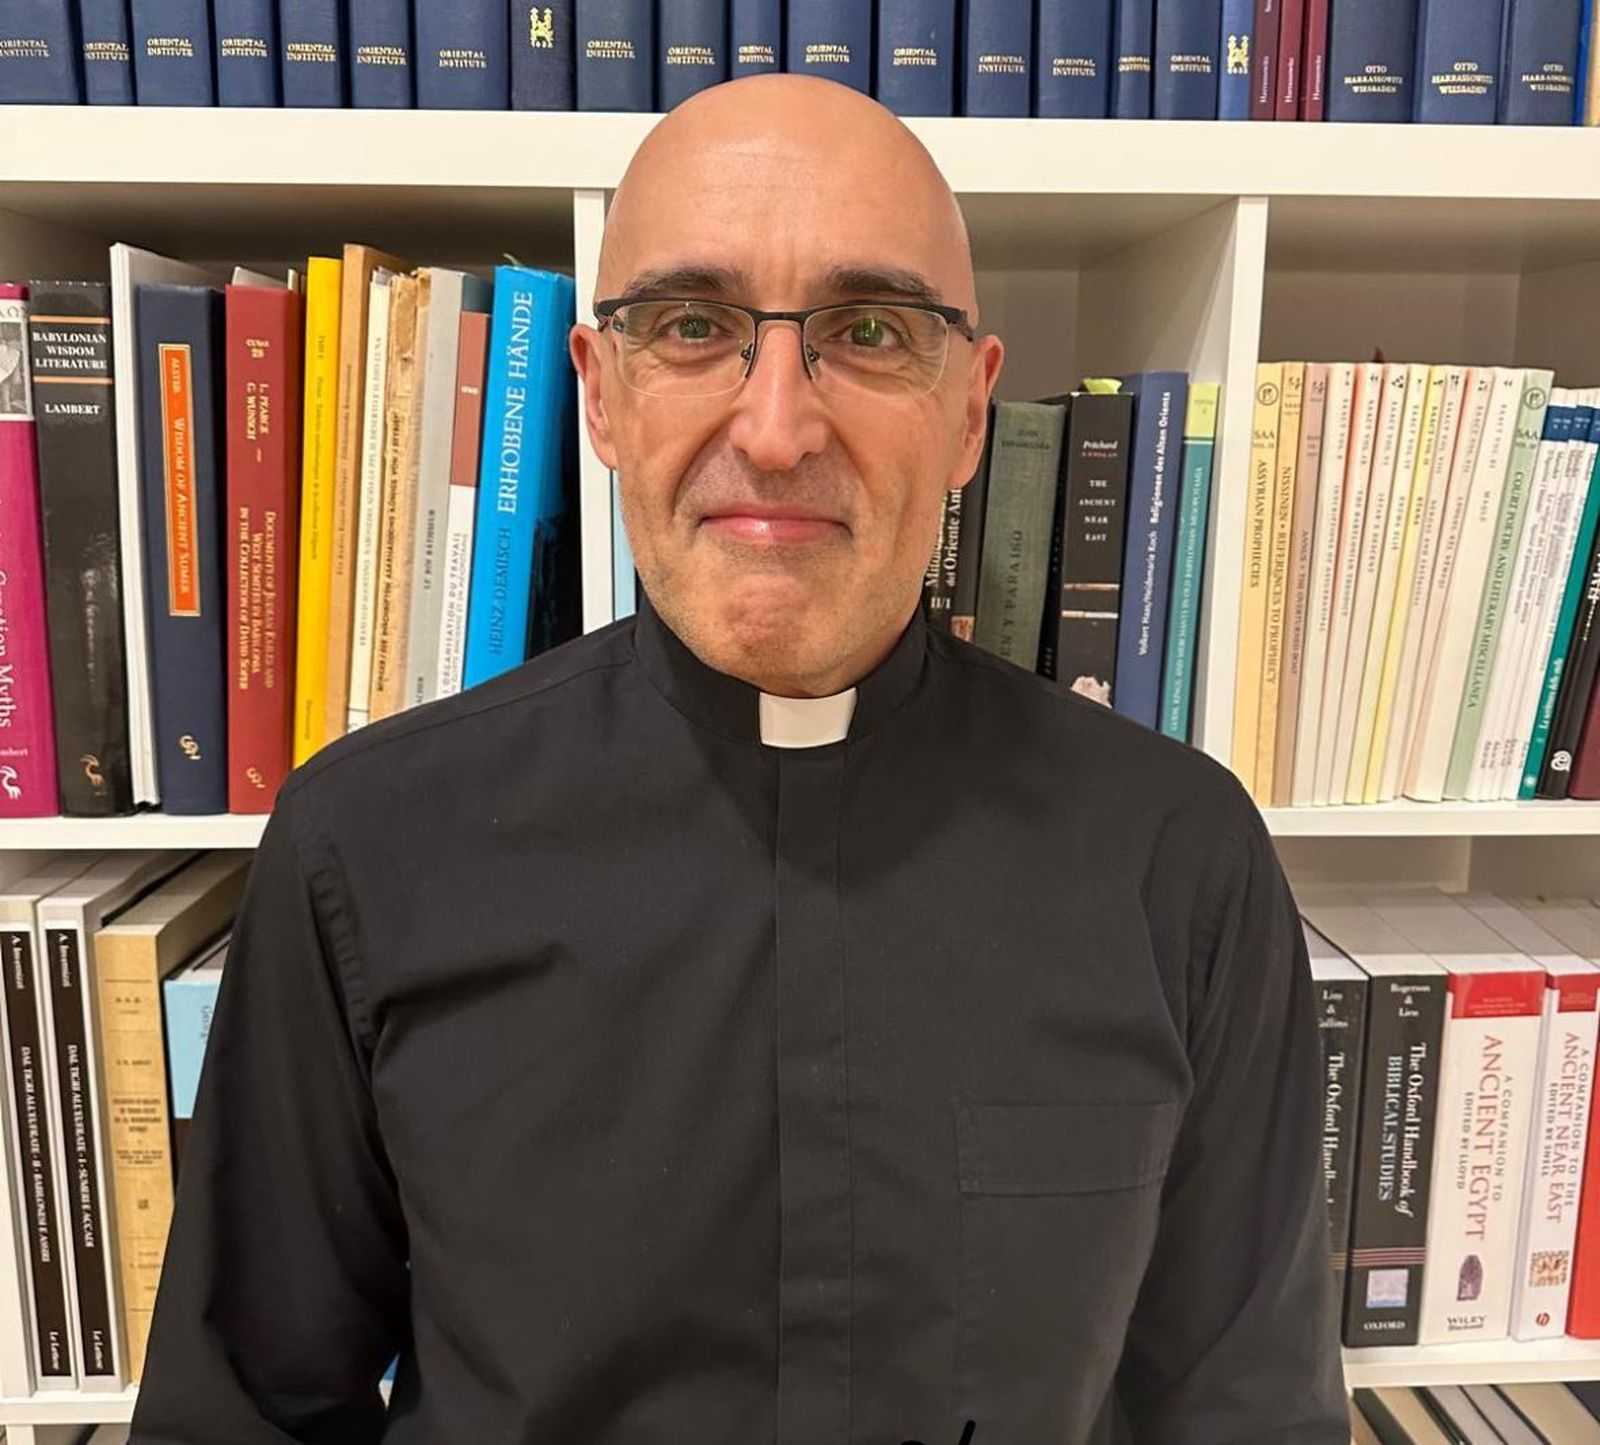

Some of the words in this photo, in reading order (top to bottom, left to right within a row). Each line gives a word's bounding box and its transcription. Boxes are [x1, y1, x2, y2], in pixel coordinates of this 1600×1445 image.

[147, 38, 192, 47] ORIENTAL
[221, 38, 267, 47] ORIENTAL
[287, 43, 336, 53] ORIENTAL
[357, 46, 405, 56] ORIENTAL
[587, 40, 634, 49] ORIENTAL
[668, 47, 713, 55] ORIENTAL
[738, 46, 774, 54] ORIENTAL
[806, 44, 849, 53] ORIENTAL
[147, 47, 194, 57] INSTITUTE
[221, 48, 268, 57] INSTITUTE
[286, 52, 337, 62] INSTITUTE
[356, 55, 407, 65] INSTITUTE
[439, 50, 486, 59] ORIENTAL
[586, 49, 635, 59] INSTITUTE
[667, 56, 715, 65] INSTITUTE
[738, 54, 774, 63] INSTITUTE
[805, 54, 850, 63] INSTITUTE
[893, 56, 937, 66] INSTITUTE
[894, 48, 936, 57] ORIENTAL
[979, 55, 1025, 65] ORIENTAL
[1171, 55, 1211, 63] ORIENTAL
[438, 59, 487, 68] INSTITUTE
[978, 64, 1026, 74] INSTITUTE
[1053, 58, 1096, 68] ORIENTAL
[1053, 67, 1096, 77] INSTITUTE
[1170, 63, 1212, 73] INSTITUTE
[1365, 65, 1387, 74] OTTO
[1454, 62, 1478, 72] OTTO
[33, 332, 107, 344] BABYLONIAN
[507, 291, 533, 379] HÄNDE
[47, 345, 95, 356] WISDOM
[35, 357, 107, 369] LITERATURE
[45, 403, 101, 415] LAMBERT
[246, 396, 256, 440] WUNSCH
[1157, 391, 1171, 427] Orients
[174, 417, 186, 469] WISDOM
[1155, 430, 1167, 455] Alten
[1255, 431, 1274, 440] SAA
[1517, 429, 1538, 439] SAA
[497, 387, 526, 515] ERHOBENE
[1153, 456, 1164, 474] des
[176, 473, 186, 488] OF
[1089, 480, 1107, 488] THE
[1253, 459, 1267, 517] ASSYRIAN
[1149, 474, 1165, 524] Religionen
[1279, 466, 1292, 523] NISSINEN
[1508, 471, 1524, 509] COURT
[1079, 498, 1116, 506] ANCIENT
[176, 494, 188, 550] ANCIENT
[1084, 516, 1108, 524] NEAR
[240, 522, 249, 541] THE
[1085, 533, 1107, 542] EAST
[1499, 511, 1516, 550] POETRY
[944, 518, 960, 570] Oriente
[1146, 531, 1158, 552] Koch
[1250, 518, 1265, 588] PROPHECIES
[494, 526, 512, 599] DEMISCH
[1271, 532, 1287, 606] REFERENCES
[1495, 556, 1508, 578] AND
[178, 552, 190, 593] SUMER
[240, 544, 250, 607] COLLECTION
[947, 571, 957, 587] del
[931, 596, 951, 609] II/1
[1483, 580, 1503, 632] LITERARY
[1002, 617, 1014, 627] Y
[1271, 608, 1281, 623] TO
[489, 601, 504, 656] HEINZ
[240, 626, 250, 657] DAVID
[1138, 625, 1150, 656] Volkert
[1266, 625, 1279, 684] PROPHECY
[1467, 634, 1492, 708] MISCELLANEA
[1404, 995, 1413, 1004] &
[1327, 1005, 1335, 1014] &
[22, 1046, 31, 1066] DAL
[68, 1045, 77, 1064] DAL
[1408, 1042, 1427, 1070] The
[1581, 1049, 1590, 1057] A
[1327, 1052, 1345, 1081] The
[1557, 1033, 1580, 1119] ANCIENT
[1383, 1056, 1402, 1131] BIBLICAL
[1405, 1074, 1423, 1122] Oxford
[1472, 1036, 1503, 1155] ANCIENT
[1324, 1084, 1341, 1132] Oxford
[1462, 1092, 1474, 1132] EDITED
[1546, 1083, 1558, 1123] EDITED
[1570, 1064, 1589, 1150] COMPANION
[1494, 1090, 1511, 1176] COMPANION
[1544, 1127, 1553, 1140] BY
[1460, 1137, 1469, 1150] BY
[1551, 1126, 1570, 1176] NEAR
[1379, 1132, 1397, 1200] STUDIES
[1399, 1126, 1420, 1198] Handbook
[1541, 1145, 1552, 1178] SNELL
[1568, 1157, 1579, 1175] TO
[1457, 1154, 1468, 1189] LLOYD
[79, 1169, 89, 1205] SUMERI
[1492, 1184, 1502, 1202] TO
[1565, 1182, 1577, 1206] THE
[1394, 1200, 1413, 1218] of
[1465, 1165, 1490, 1241] EGYPT
[1546, 1183, 1564, 1224] EAST
[82, 1213, 95, 1247] ACCADI
[1364, 1321, 1405, 1331] OXFORD
[1448, 1315, 1485, 1325] WILEY
